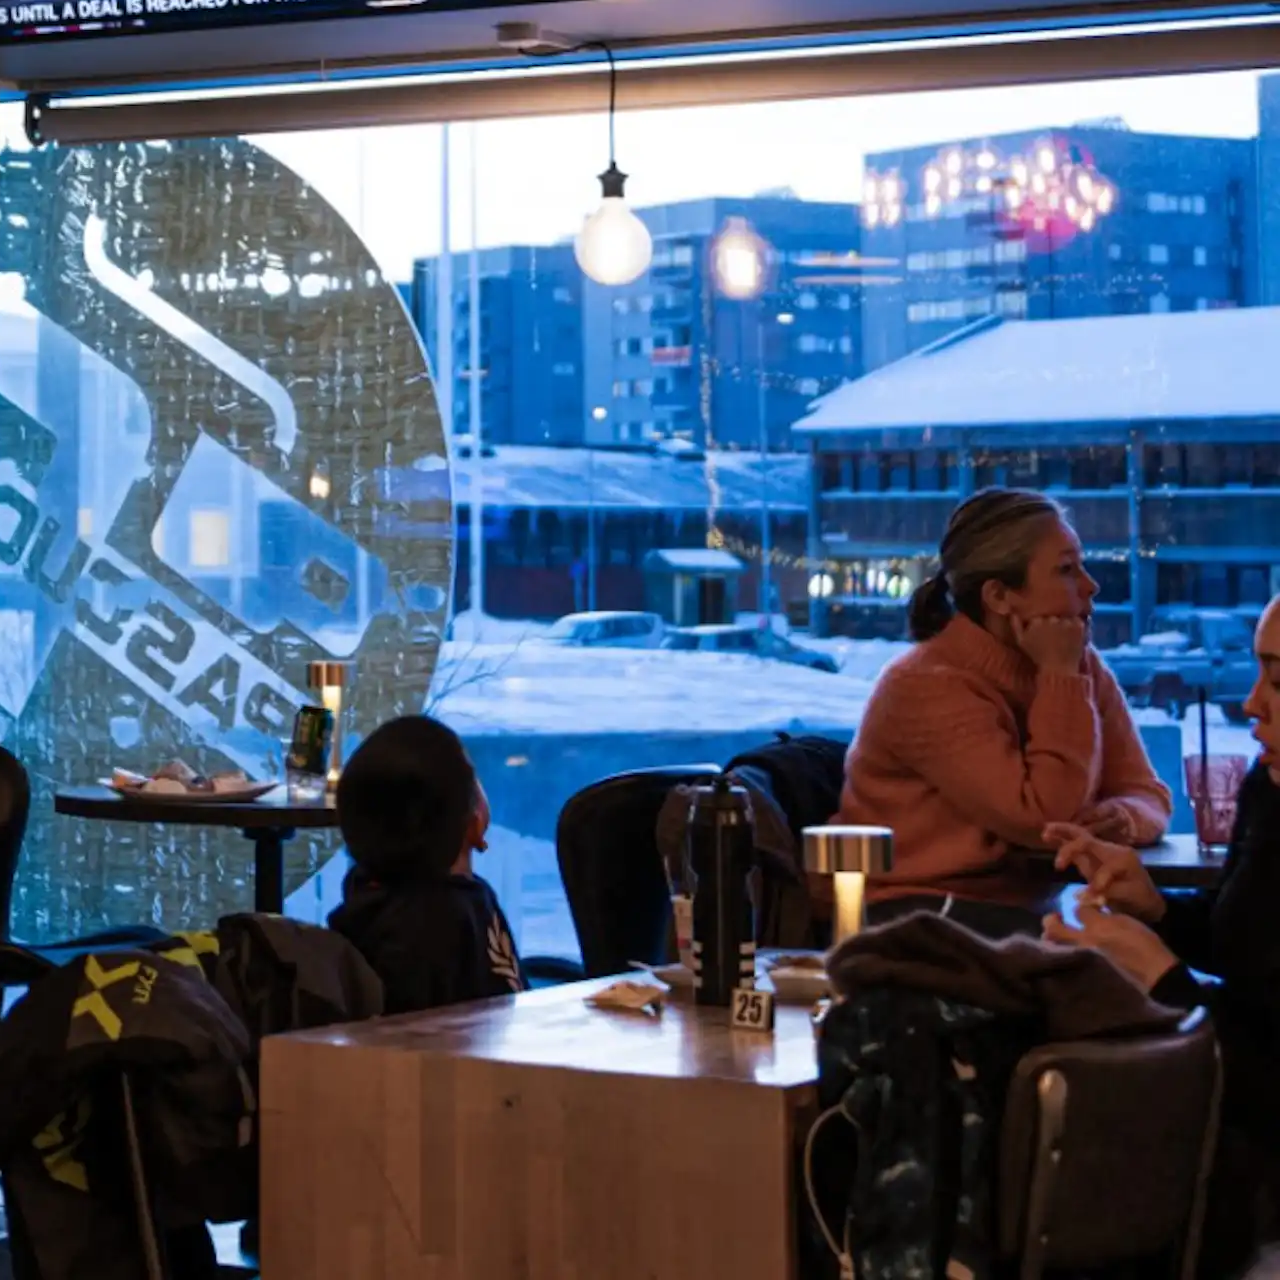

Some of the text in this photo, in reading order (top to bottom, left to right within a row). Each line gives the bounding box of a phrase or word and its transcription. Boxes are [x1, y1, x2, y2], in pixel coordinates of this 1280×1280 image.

[11, 1, 60, 24] UNTIL
[61, 3, 75, 20] A
[736, 993, 763, 1024] 25
